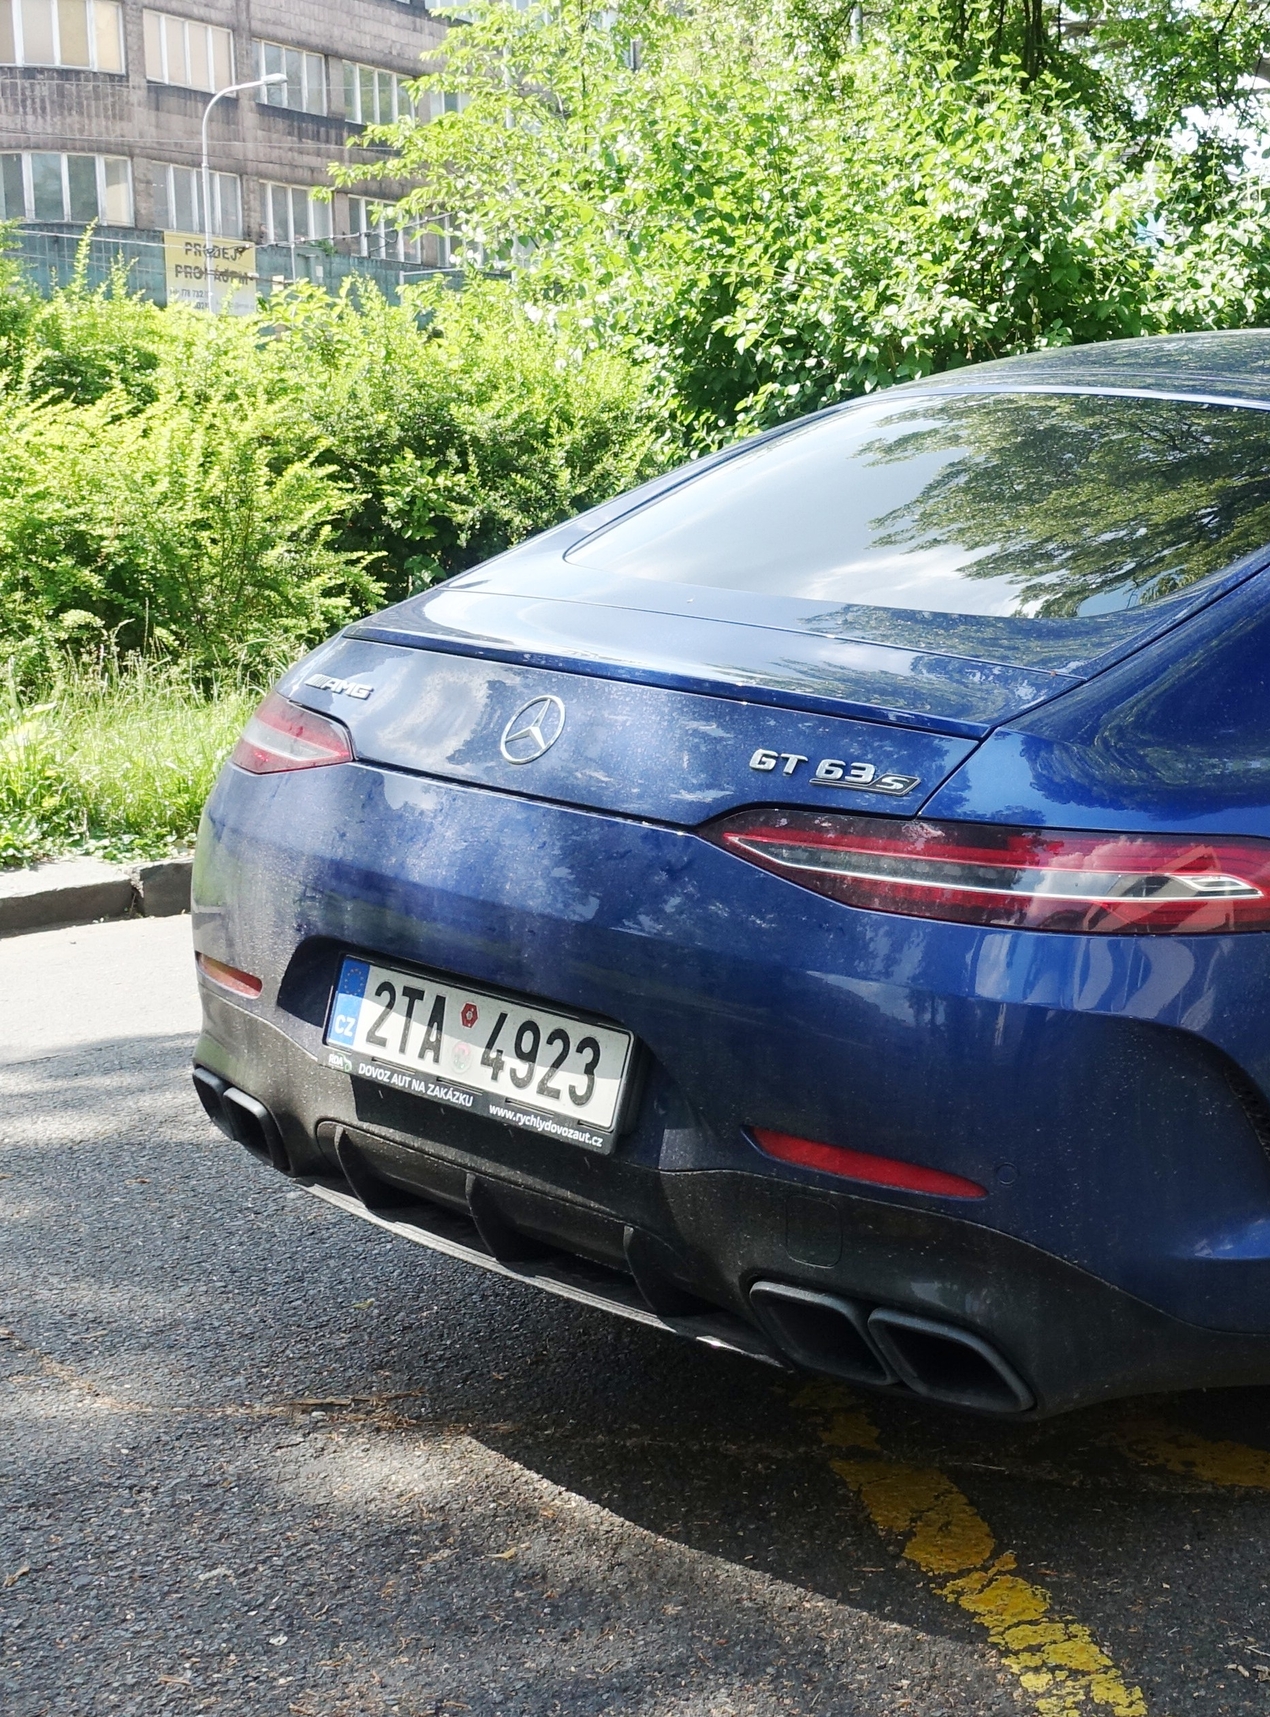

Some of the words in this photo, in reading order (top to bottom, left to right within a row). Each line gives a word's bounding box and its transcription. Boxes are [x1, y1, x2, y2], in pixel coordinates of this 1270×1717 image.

[317, 677, 374, 700] AMG
[749, 748, 808, 776] GT
[815, 758, 876, 784] 63
[334, 1013, 355, 1038] CZ
[365, 980, 447, 1064] 2TA
[480, 1011, 602, 1107] 4923
[328, 1053, 344, 1067] RDA
[358, 1062, 390, 1083] DOVOZ
[391, 1074, 411, 1089] AUT
[411, 1079, 426, 1094] NA
[427, 1083, 474, 1108] ZAKÁZKU
[488, 1103, 604, 1148] www.rychlydovozaut.cz
